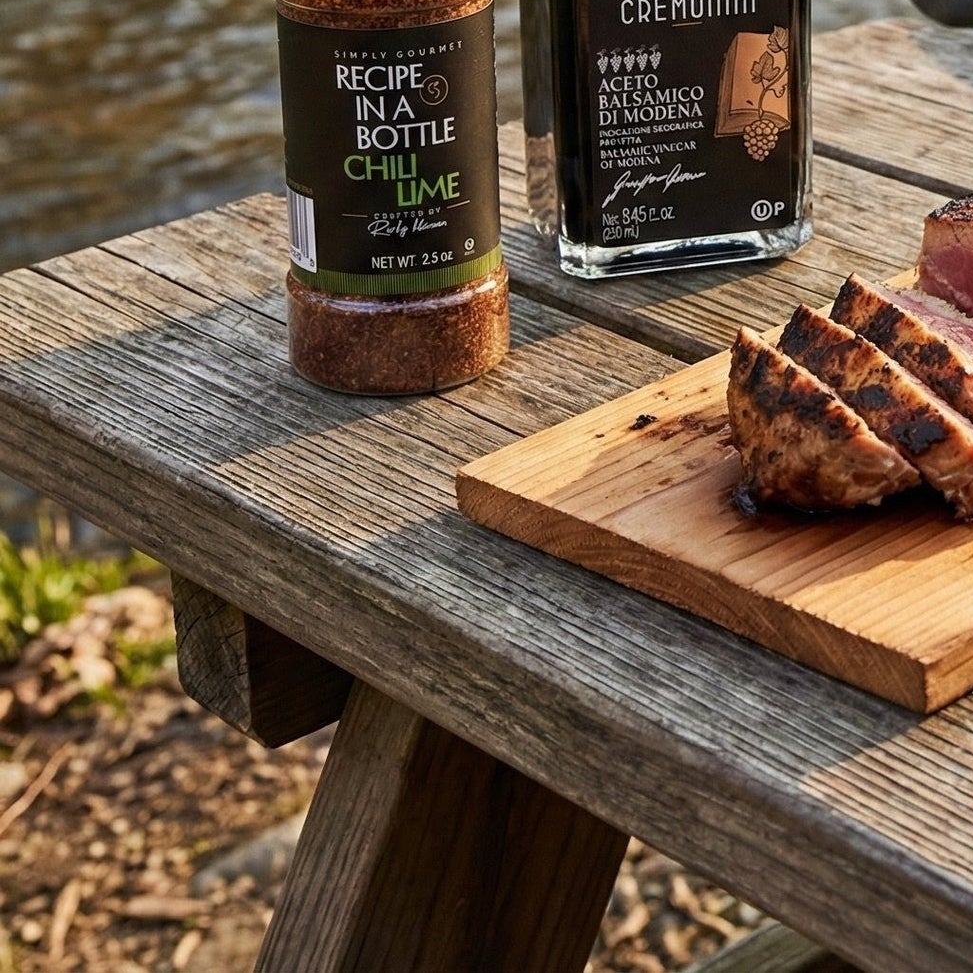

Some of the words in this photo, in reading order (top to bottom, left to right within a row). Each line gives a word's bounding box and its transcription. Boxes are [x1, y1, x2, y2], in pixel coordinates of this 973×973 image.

[334, 49, 388, 60] SIMPLY
[396, 40, 463, 59] GOURMET
[336, 63, 424, 91] RECIPE
[598, 73, 658, 93] ACETO
[356, 95, 385, 121] IN
[392, 95, 415, 121] A
[599, 85, 704, 110] BALSAMICO
[599, 110, 617, 126] DI
[624, 102, 703, 124] MODENA
[356, 117, 456, 150] BOTTLE
[343, 153, 417, 180] CHILI
[397, 172, 460, 207] LIME
[371, 256, 394, 269] NET
